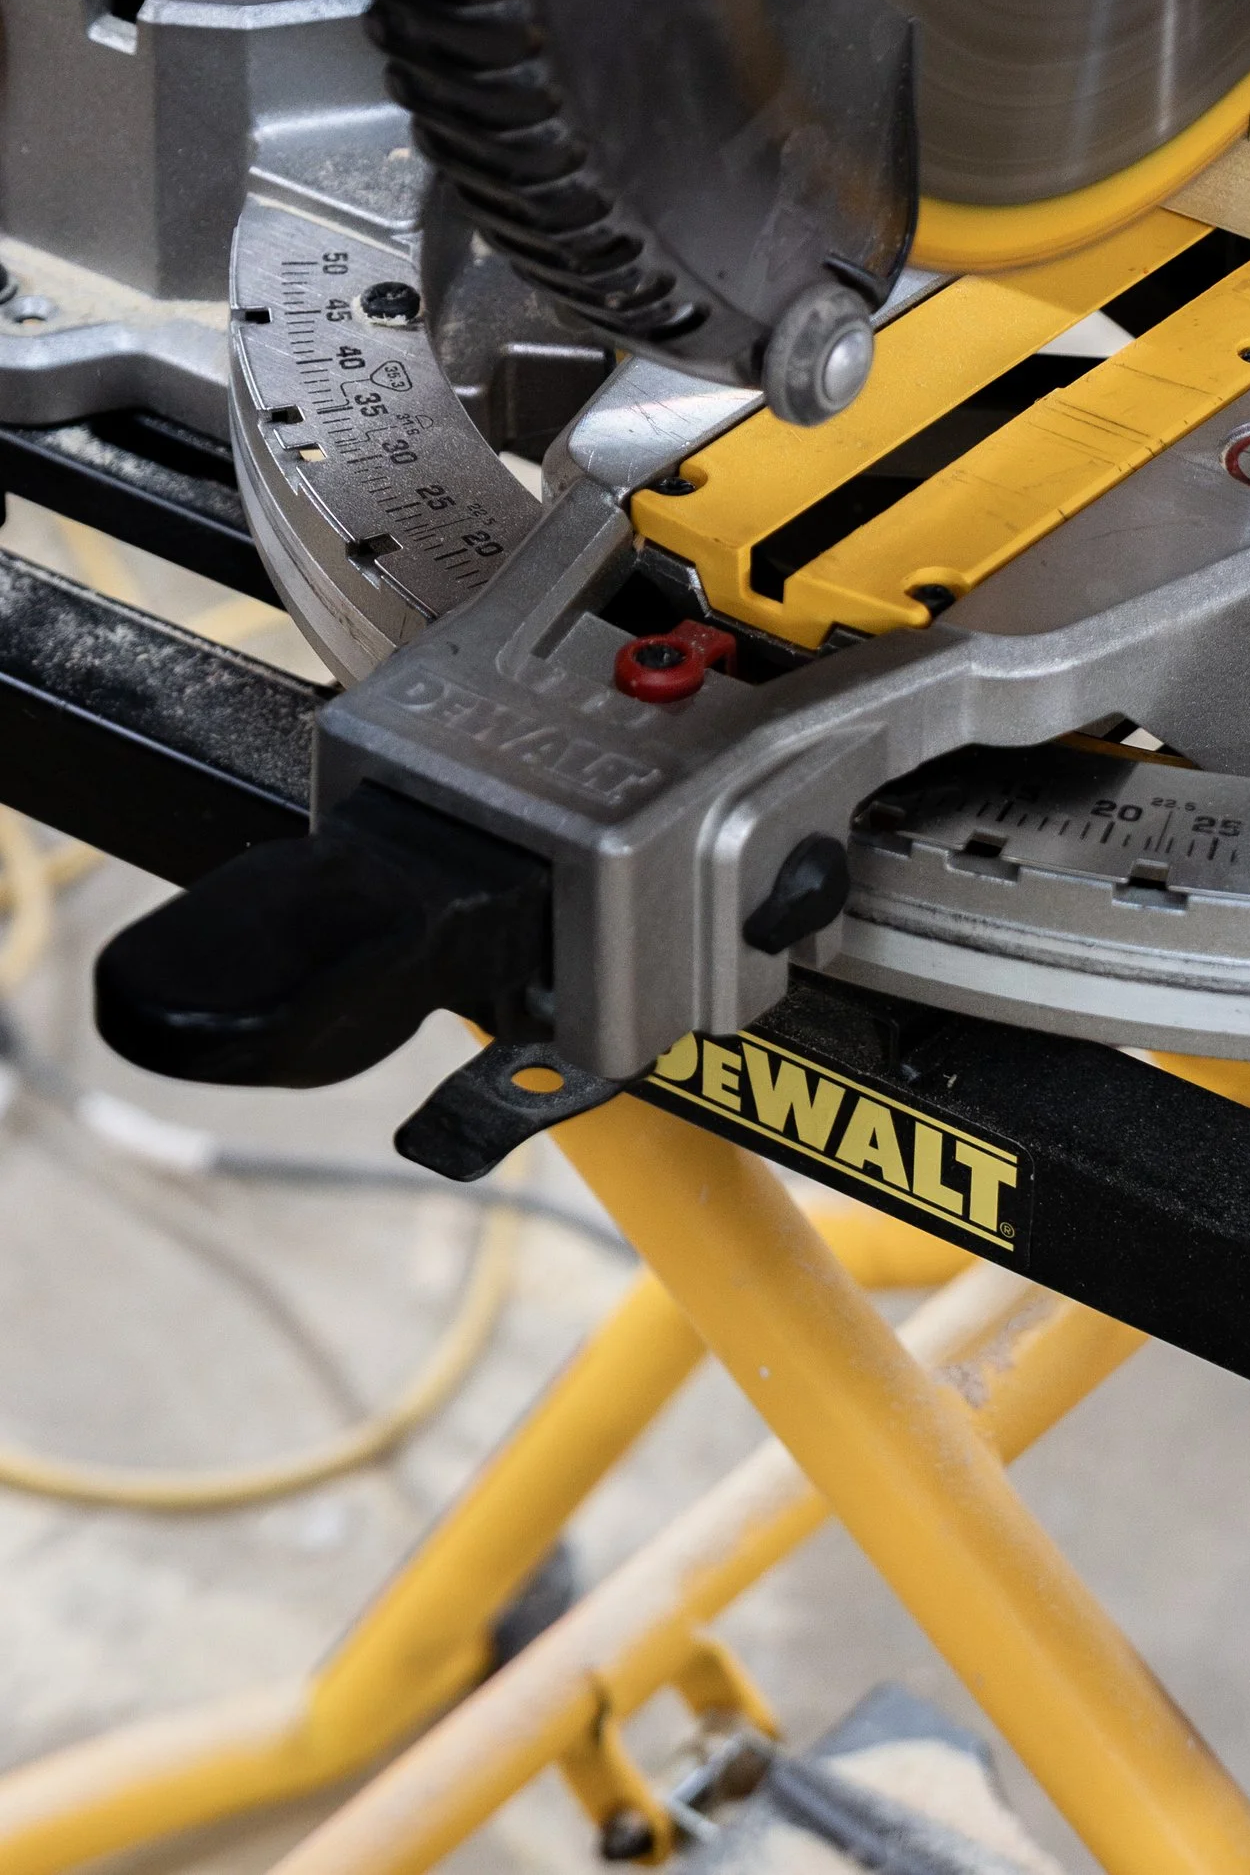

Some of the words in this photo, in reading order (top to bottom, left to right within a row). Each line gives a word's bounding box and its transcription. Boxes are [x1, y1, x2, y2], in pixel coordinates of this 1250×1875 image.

[322, 252, 348, 275] 50
[325, 299, 352, 322] 45
[336, 346, 366, 370] 40
[354, 393, 389, 418] 35
[382, 439, 418, 465] 30
[415, 484, 456, 511] 25
[461, 530, 504, 557] 20
[1091, 800, 1142, 822] 20
[1150, 797, 1196, 812] 22.5
[1191, 815, 1243, 837] 25
